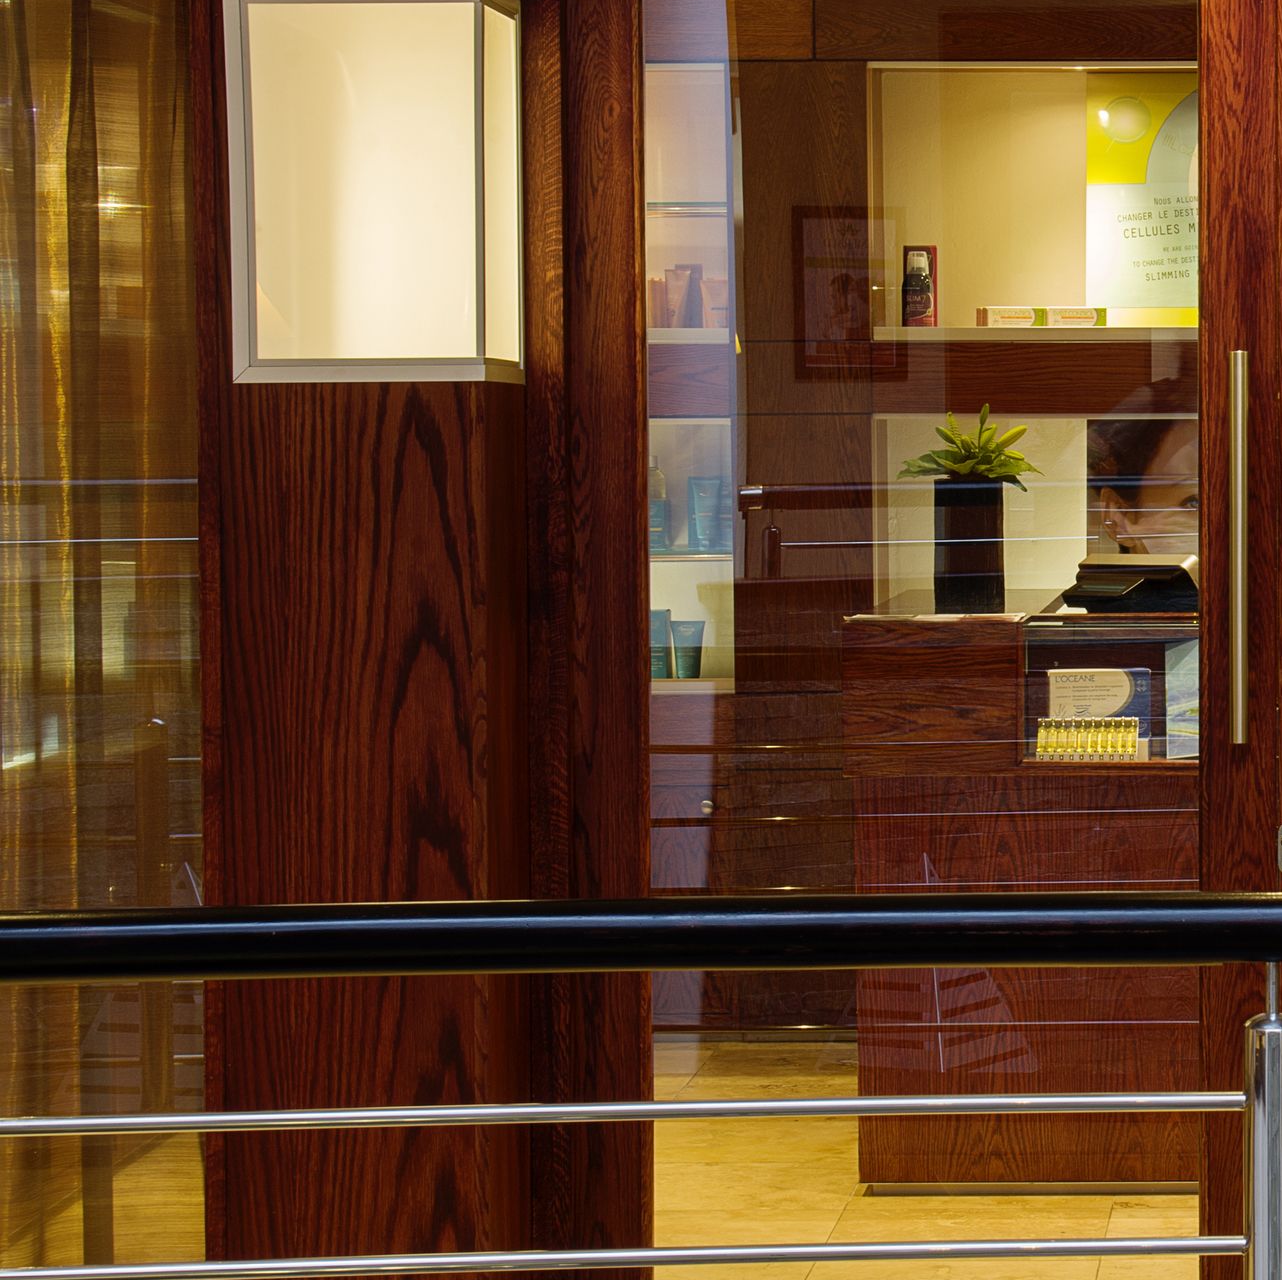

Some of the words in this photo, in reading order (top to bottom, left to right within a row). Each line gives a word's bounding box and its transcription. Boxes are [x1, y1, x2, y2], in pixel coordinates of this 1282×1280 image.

[1117, 211, 1153, 223] CHANGER
[1158, 209, 1169, 219] LE
[1123, 223, 1180, 239] CELLULES
[1167, 257, 1179, 265] THE
[1145, 269, 1190, 281] SLIMMING
[1055, 674, 1096, 683] L'OCEANE
